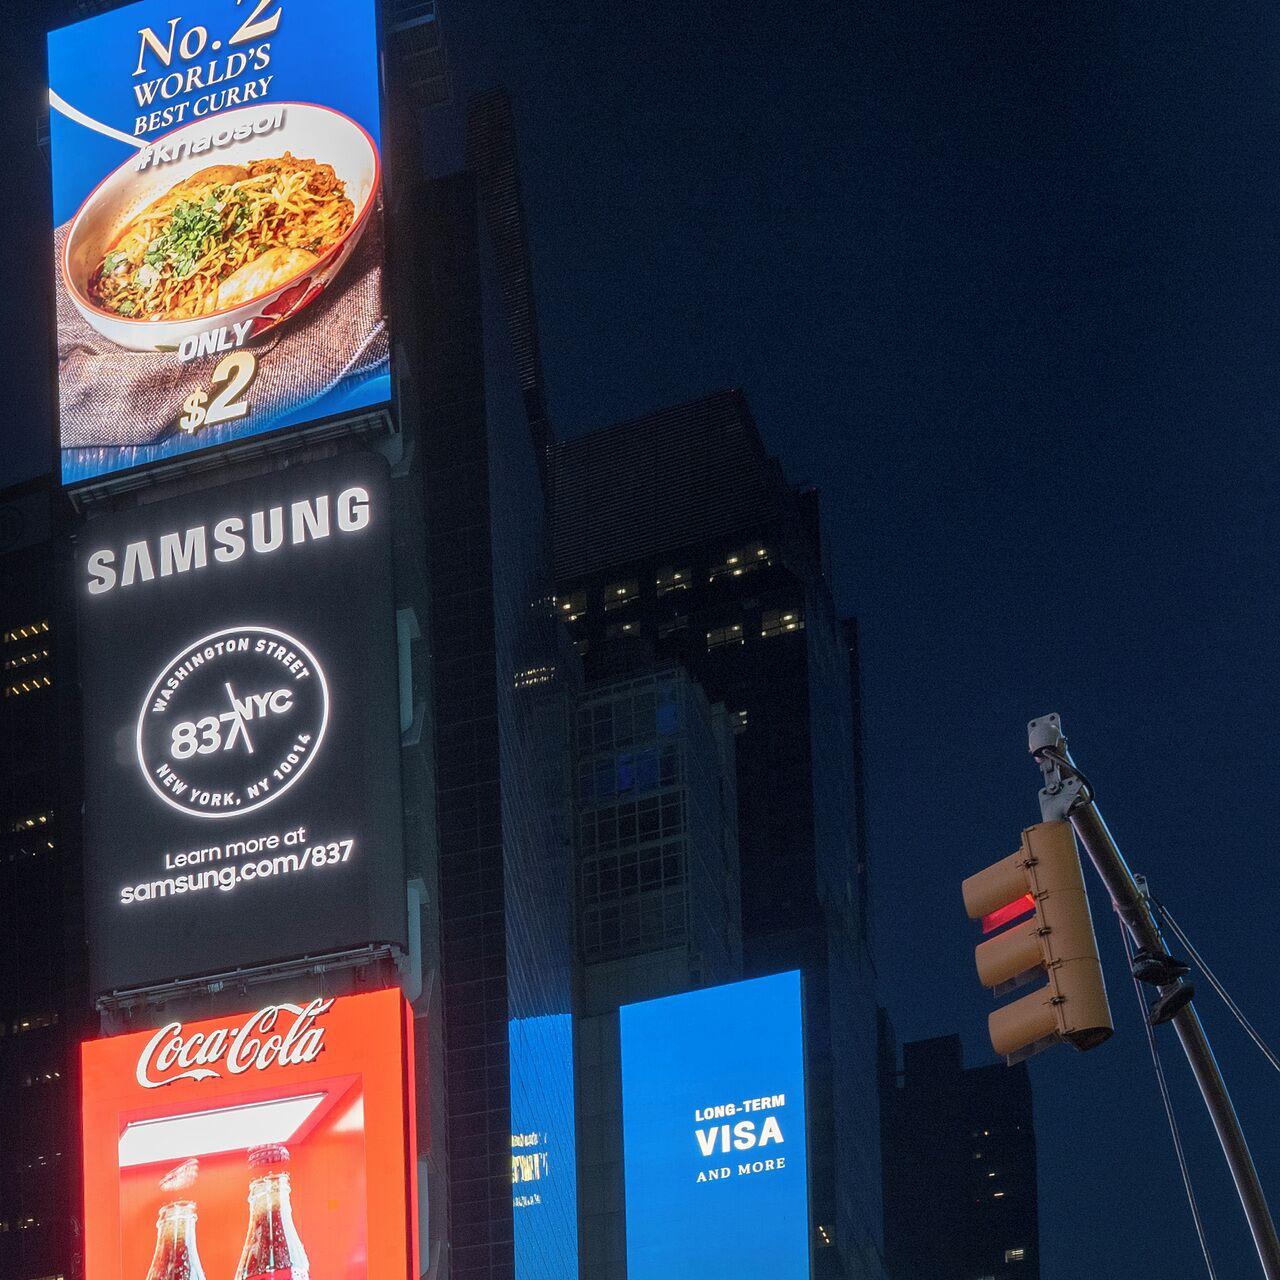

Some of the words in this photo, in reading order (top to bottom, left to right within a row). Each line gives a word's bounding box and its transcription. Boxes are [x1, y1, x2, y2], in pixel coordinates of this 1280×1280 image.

[132, 43, 272, 107] WORLD'S
[133, 101, 190, 137] BEST
[193, 75, 274, 118] CURRY
[177, 320, 253, 362] ONLY
[179, 350, 260, 434] $2
[87, 487, 371, 595] SAMSUNG
[152, 637, 251, 714] WASHINGTON
[255, 638, 311, 682] STREET
[155, 762, 186, 793] NEW
[189, 789, 242, 807] YORK,
[247, 780, 270, 800] NY
[272, 732, 311, 780] 10014
[120, 839, 354, 905] samsung.com/837
[165, 842, 221, 869] Learn
[225, 835, 280, 857] more
[283, 826, 307, 847] at
[694, 1115, 784, 1157] VISA
[695, 1093, 785, 1122] LONG-TERM
[696, 1166, 731, 1183] AND
[737, 1157, 786, 1177] MORE
